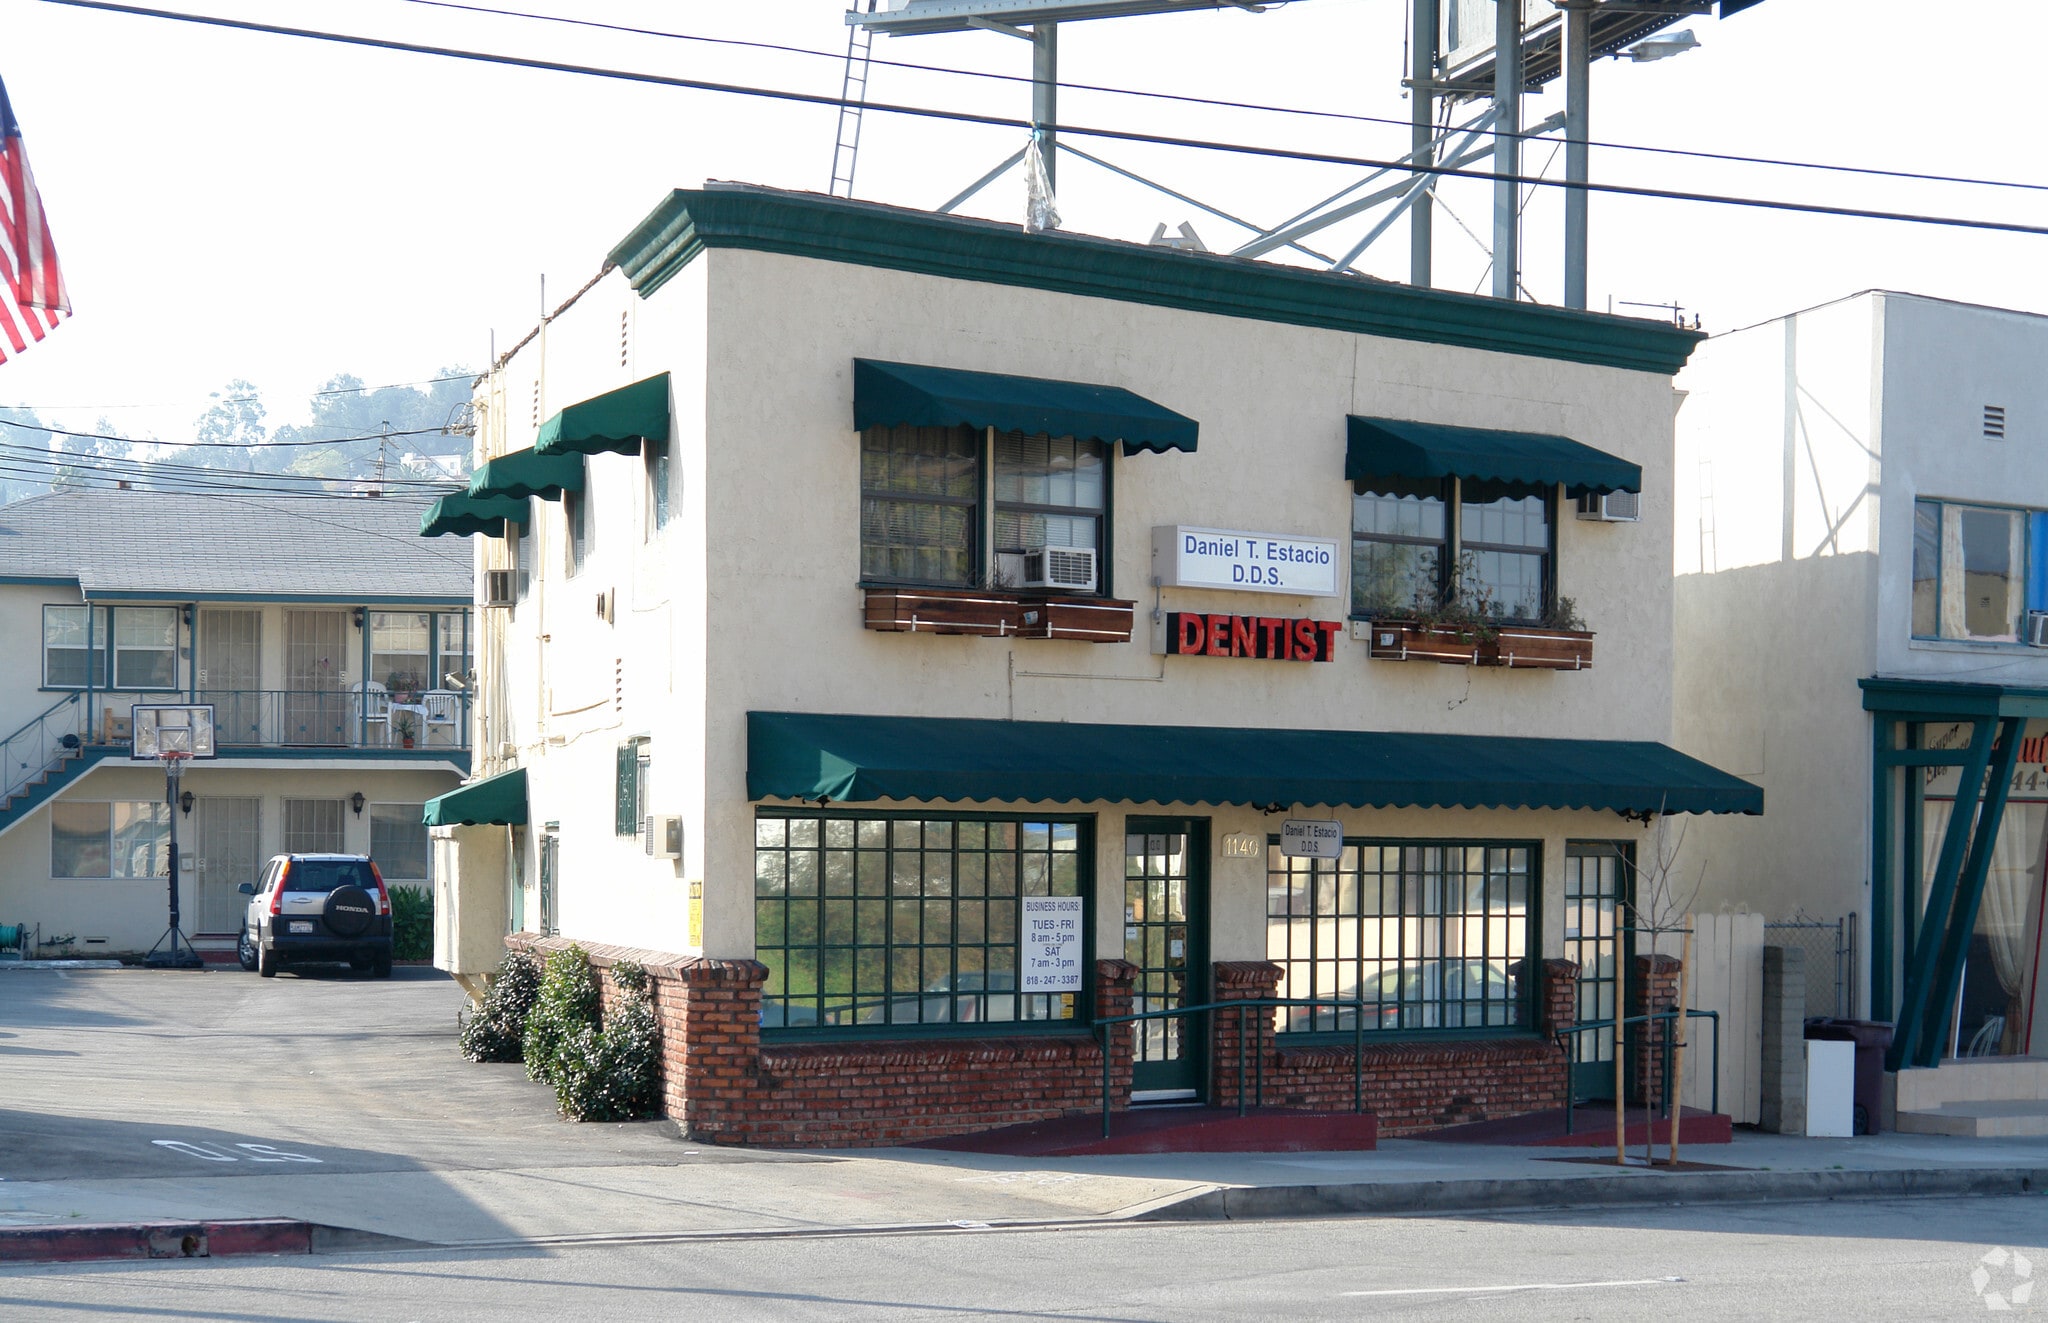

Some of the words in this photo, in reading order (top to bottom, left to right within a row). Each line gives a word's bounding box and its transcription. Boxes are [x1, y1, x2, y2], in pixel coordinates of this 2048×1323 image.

[1185, 535, 1239, 557] Daniel
[1246, 540, 1259, 559] T.
[1266, 541, 1330, 565] Estacio
[1232, 564, 1284, 586] D.D.S.
[1178, 612, 1342, 663] DENTIST
[1285, 824, 1305, 836] Daniel
[1307, 825, 1312, 837] T.
[1314, 826, 1337, 839] Estacio
[1225, 838, 1259, 856] 1140
[1301, 840, 1320, 852] D.D.S.
[335, 904, 369, 914] HONDA
[1026, 901, 1056, 912] BUSINESS
[1057, 901, 1080, 911] HOURS:
[1032, 919, 1055, 930] TUES
[1060, 919, 1074, 929] FRI
[1031, 933, 1036, 942] 8
[1037, 934, 1050, 942] am
[1056, 933, 1061, 942] 5
[1062, 934, 1075, 944] pm
[1045, 946, 1061, 956] SAT
[1031, 958, 1036, 968] 7
[1037, 960, 1050, 968] am
[1055, 958, 1060, 967] 3
[1062, 959, 1075, 969] pm
[1026, 976, 1038, 985] 818
[1044, 976, 1056, 984] 247
[1062, 975, 1079, 984] 3387
